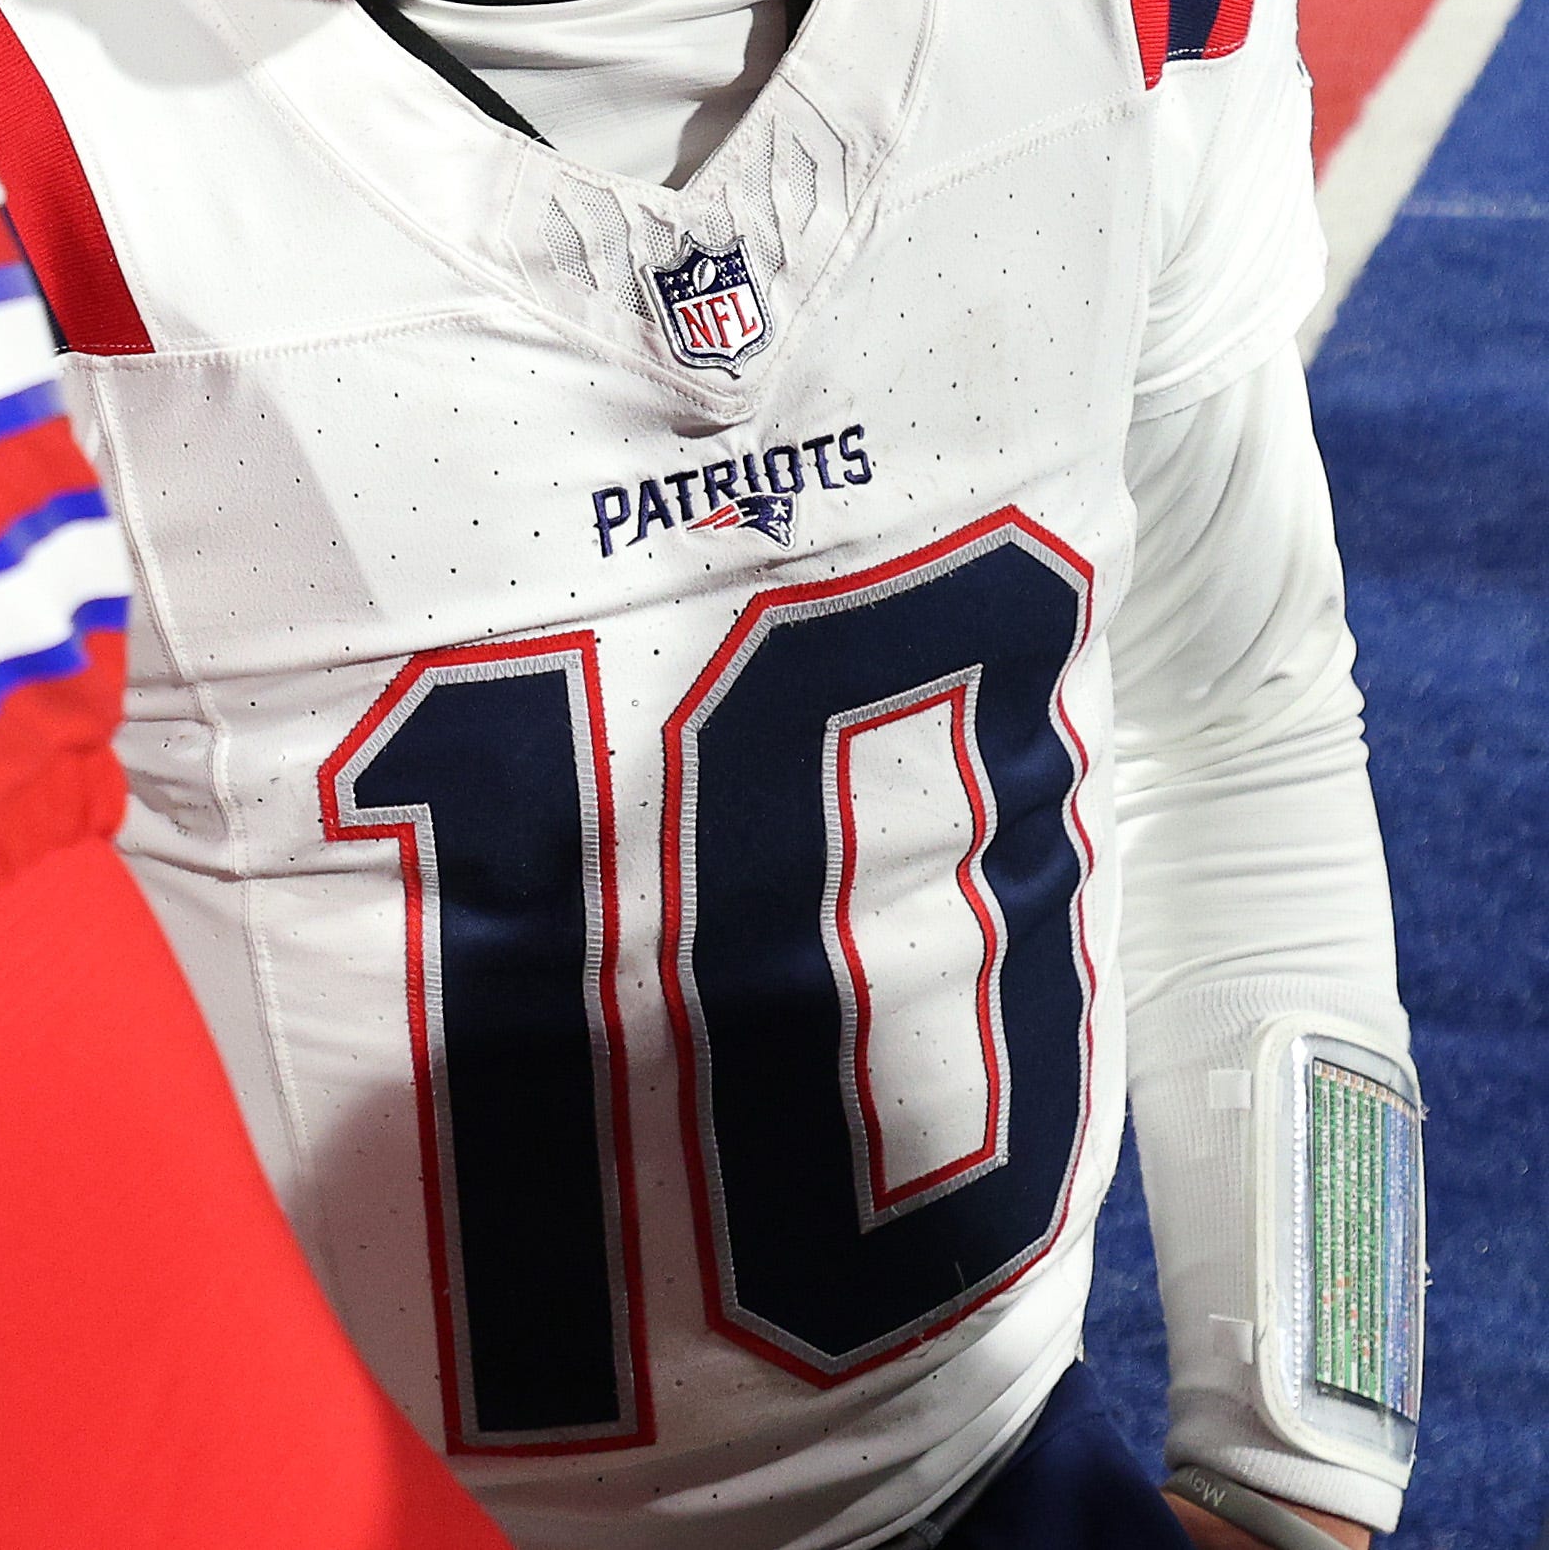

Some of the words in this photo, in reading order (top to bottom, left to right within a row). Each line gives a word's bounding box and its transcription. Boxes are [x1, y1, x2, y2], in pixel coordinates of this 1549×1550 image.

[678, 292, 758, 349] NFL
[591, 423, 873, 558] PATRIOTS
[318, 504, 1096, 1455] 10
